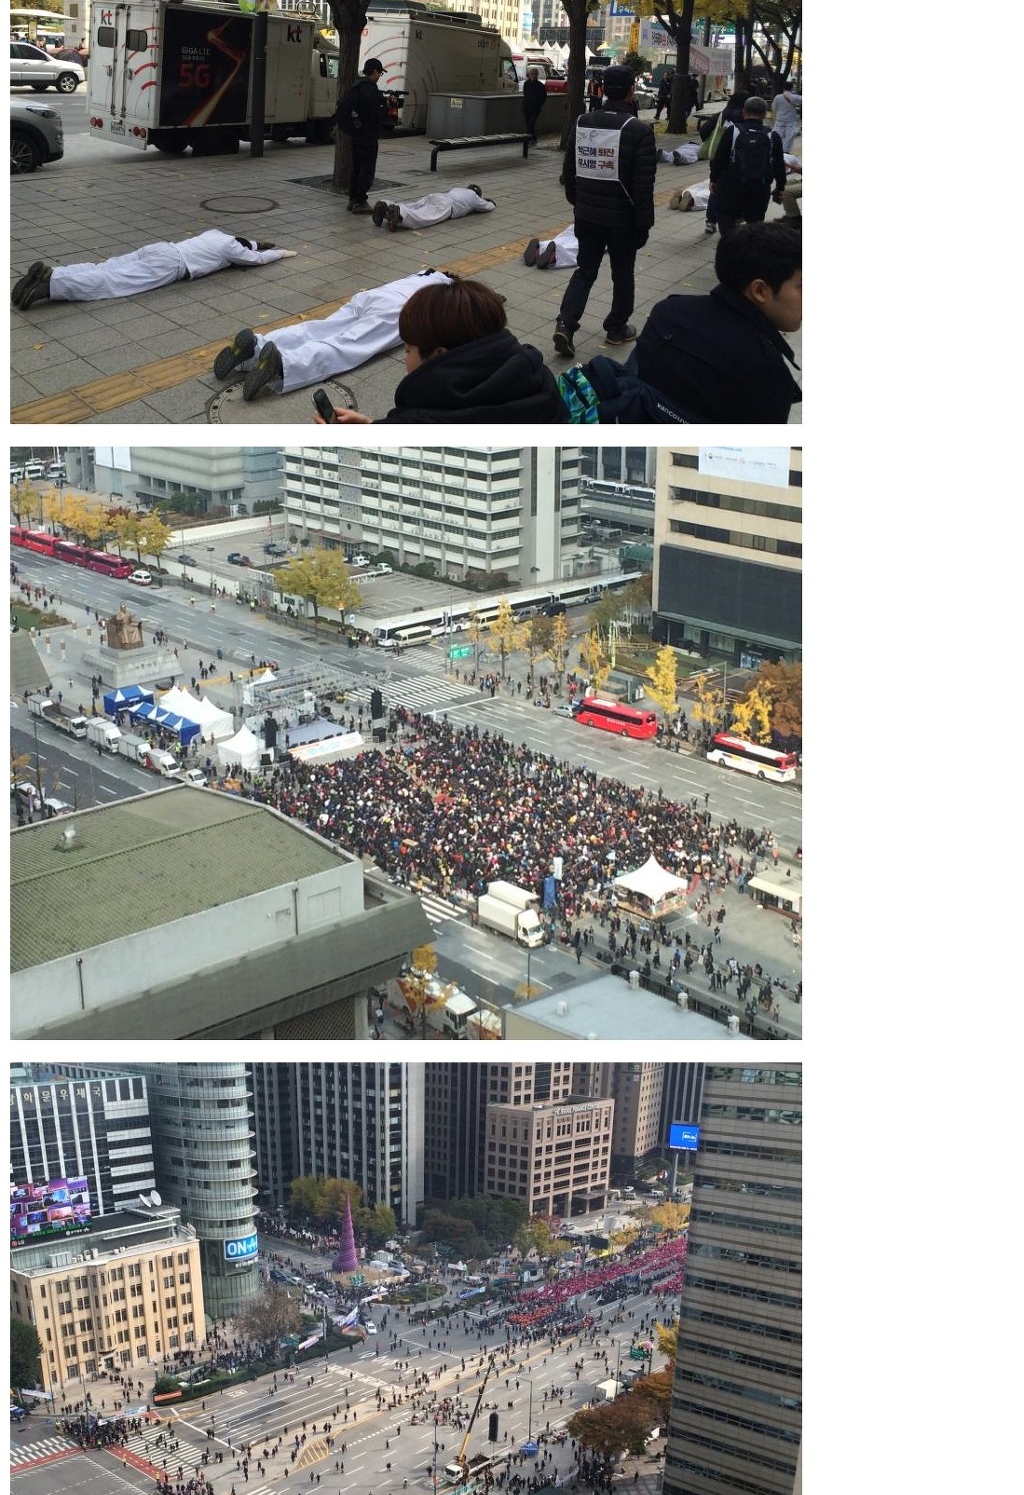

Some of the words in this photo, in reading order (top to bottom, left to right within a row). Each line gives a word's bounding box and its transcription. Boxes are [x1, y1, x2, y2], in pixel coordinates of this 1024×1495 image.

[100, 9, 113, 26] kt
[286, 24, 303, 43] kt
[181, 46, 198, 55] GIGA
[179, 62, 210, 88] 5G
[578, 146, 597, 157] 박근혜
[598, 147, 615, 158] 퇴진
[598, 160, 615, 171] 구속
[656, 401, 691, 425] vancouv
